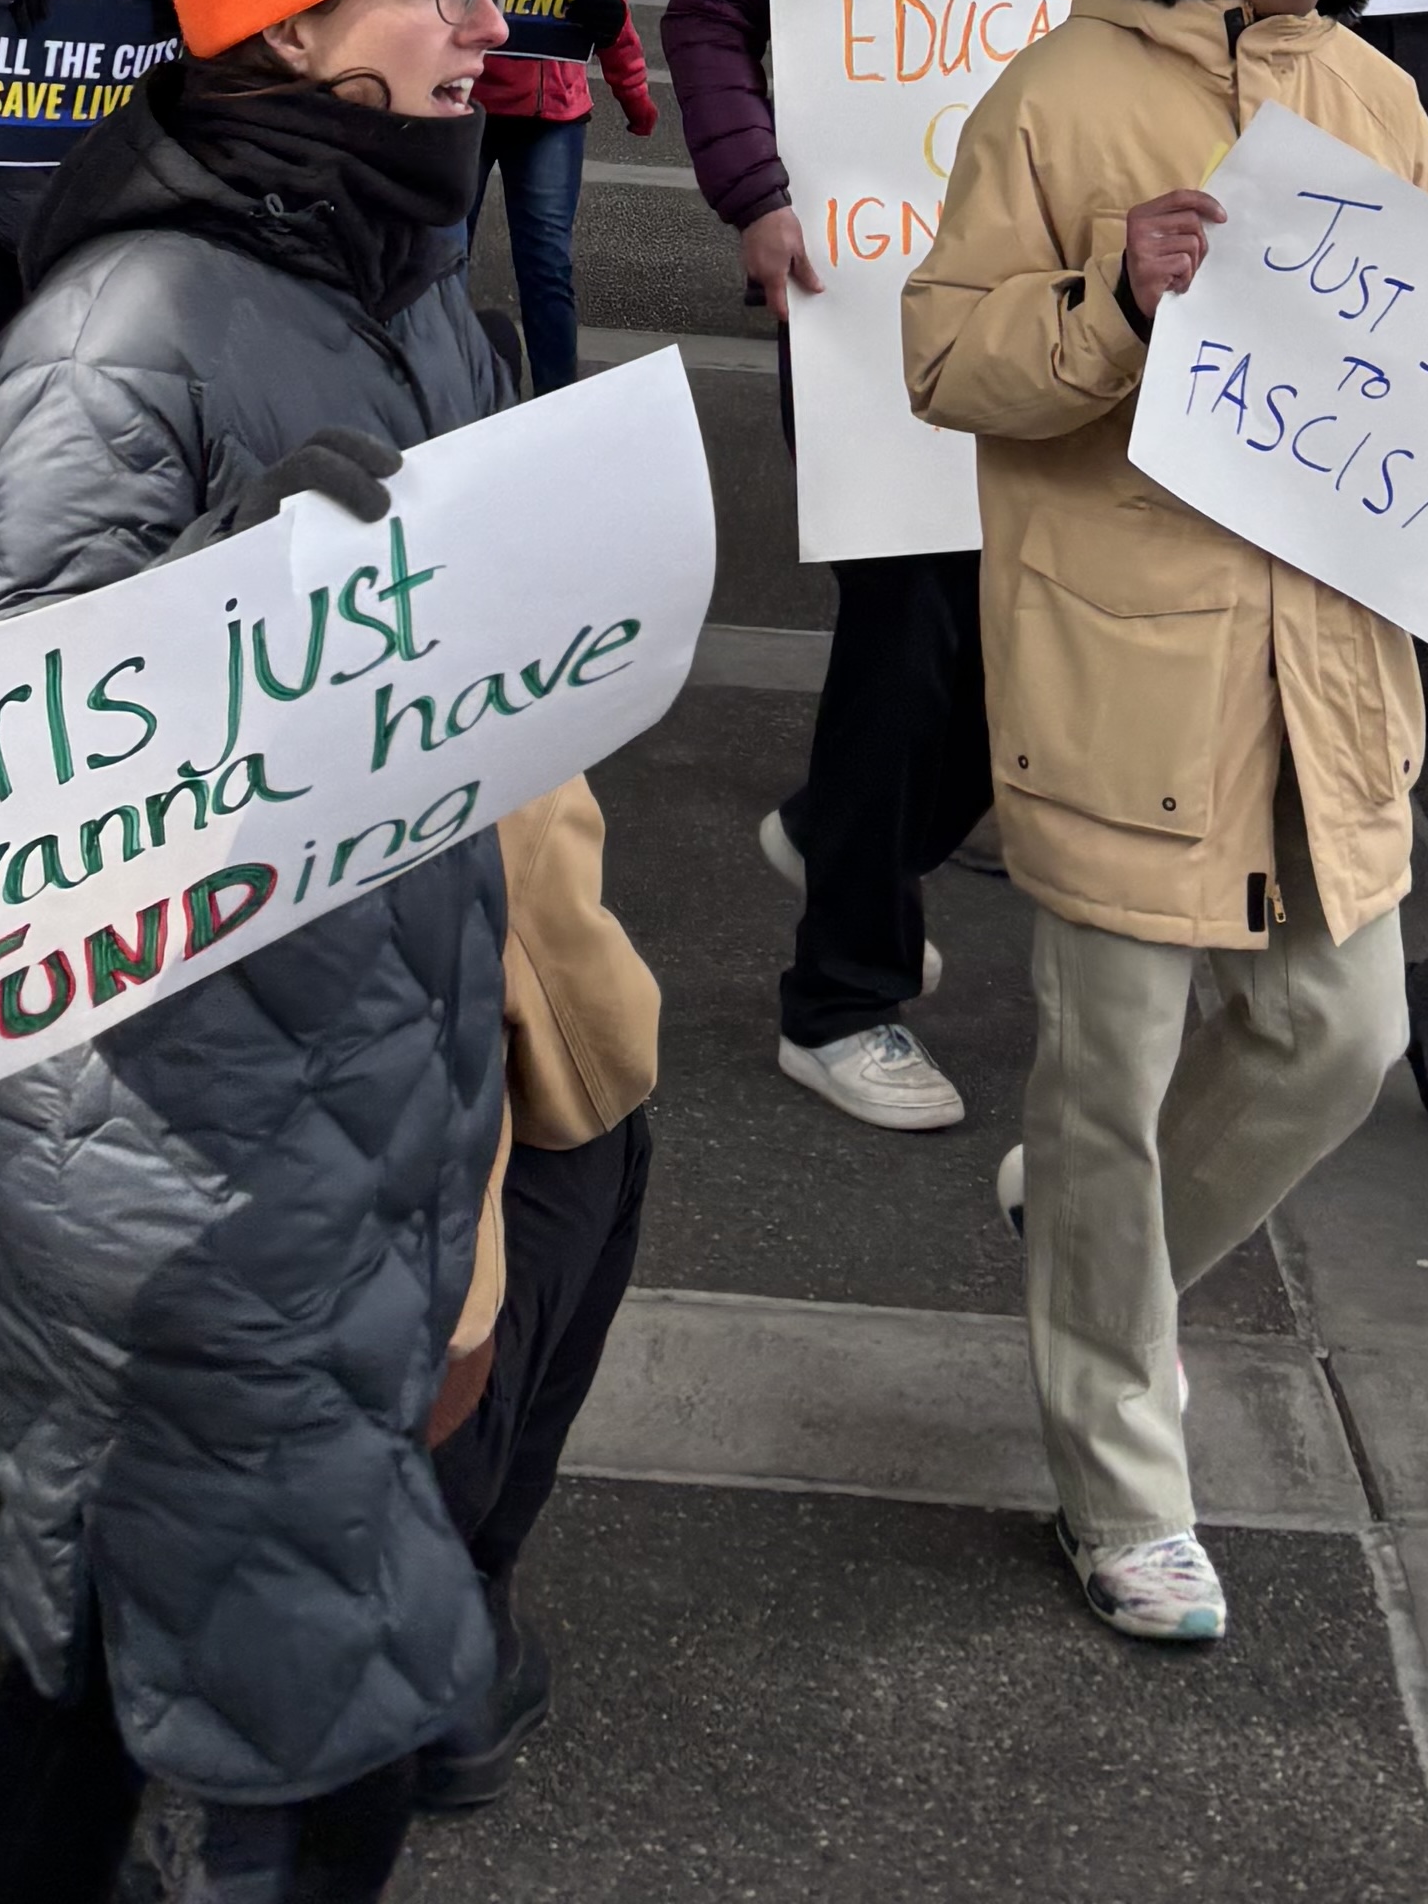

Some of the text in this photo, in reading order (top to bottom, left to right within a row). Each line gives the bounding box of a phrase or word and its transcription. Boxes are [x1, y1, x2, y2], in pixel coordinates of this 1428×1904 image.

[44, 40, 105, 79] THE
[112, 38, 177, 79] CUTS
[1264, 191, 1415, 332] JUST
[1338, 356, 1391, 399] TO
[177, 515, 448, 780] just
[372, 616, 642, 774] have
